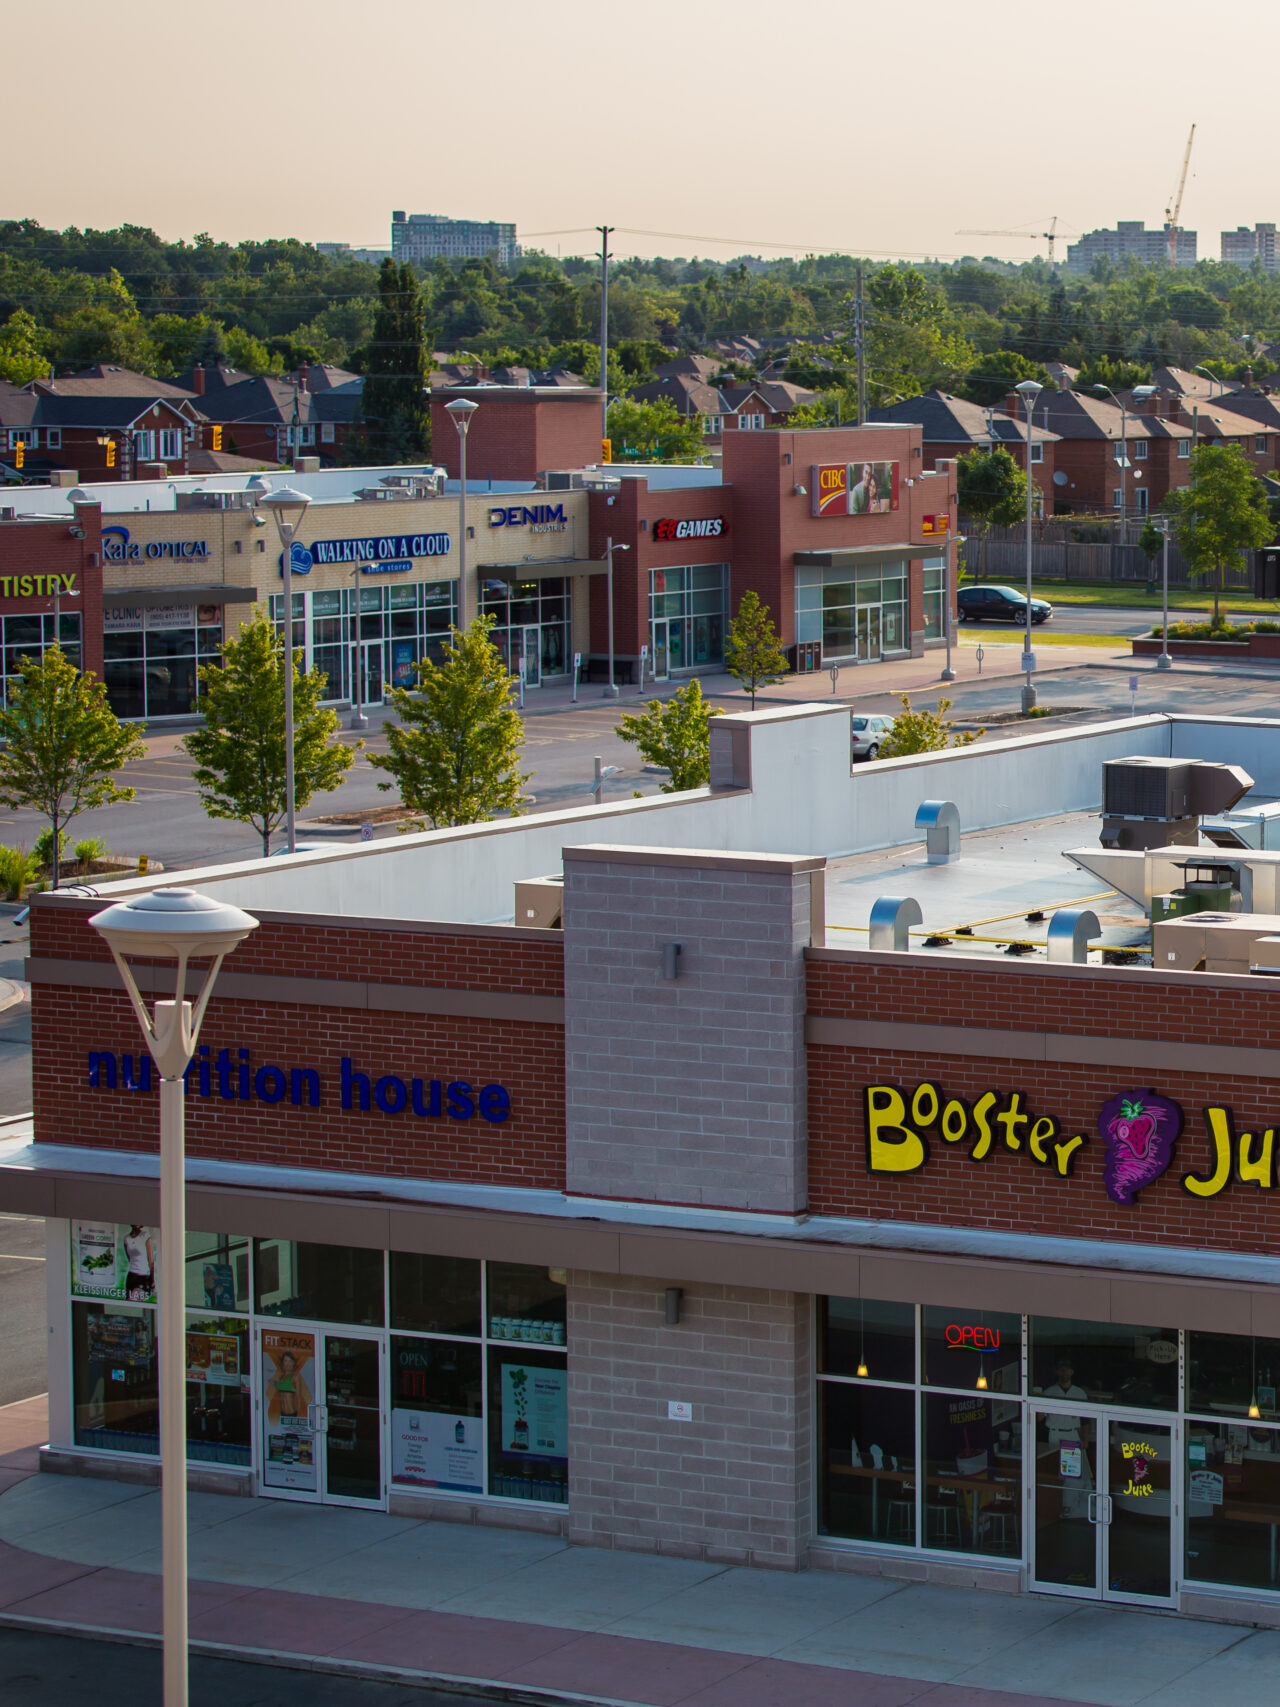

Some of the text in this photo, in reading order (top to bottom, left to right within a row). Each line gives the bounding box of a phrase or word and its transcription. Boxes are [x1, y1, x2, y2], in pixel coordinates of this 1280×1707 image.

[820, 469, 846, 488] CIBC
[676, 519, 722, 538] GAMES
[102, 538, 210, 560] Kara OPTICAL
[317, 534, 452, 563] WALKING ON A CLOUD
[387, 564, 411, 572] stores
[399, 663, 412, 677] SALE
[88, 1045, 510, 1124] nurition house
[864, 1080, 1087, 1177] Booster
[129, 1290, 151, 1300] LABS
[265, 1335, 313, 1350] FIT STACK
[945, 1324, 1000, 1348] OPEN
[399, 1351, 428, 1367] OPEN
[949, 1408, 987, 1424] FRESHNESS
[1121, 1442, 1158, 1459] Booster
[1123, 1479, 1154, 1497] Juice
